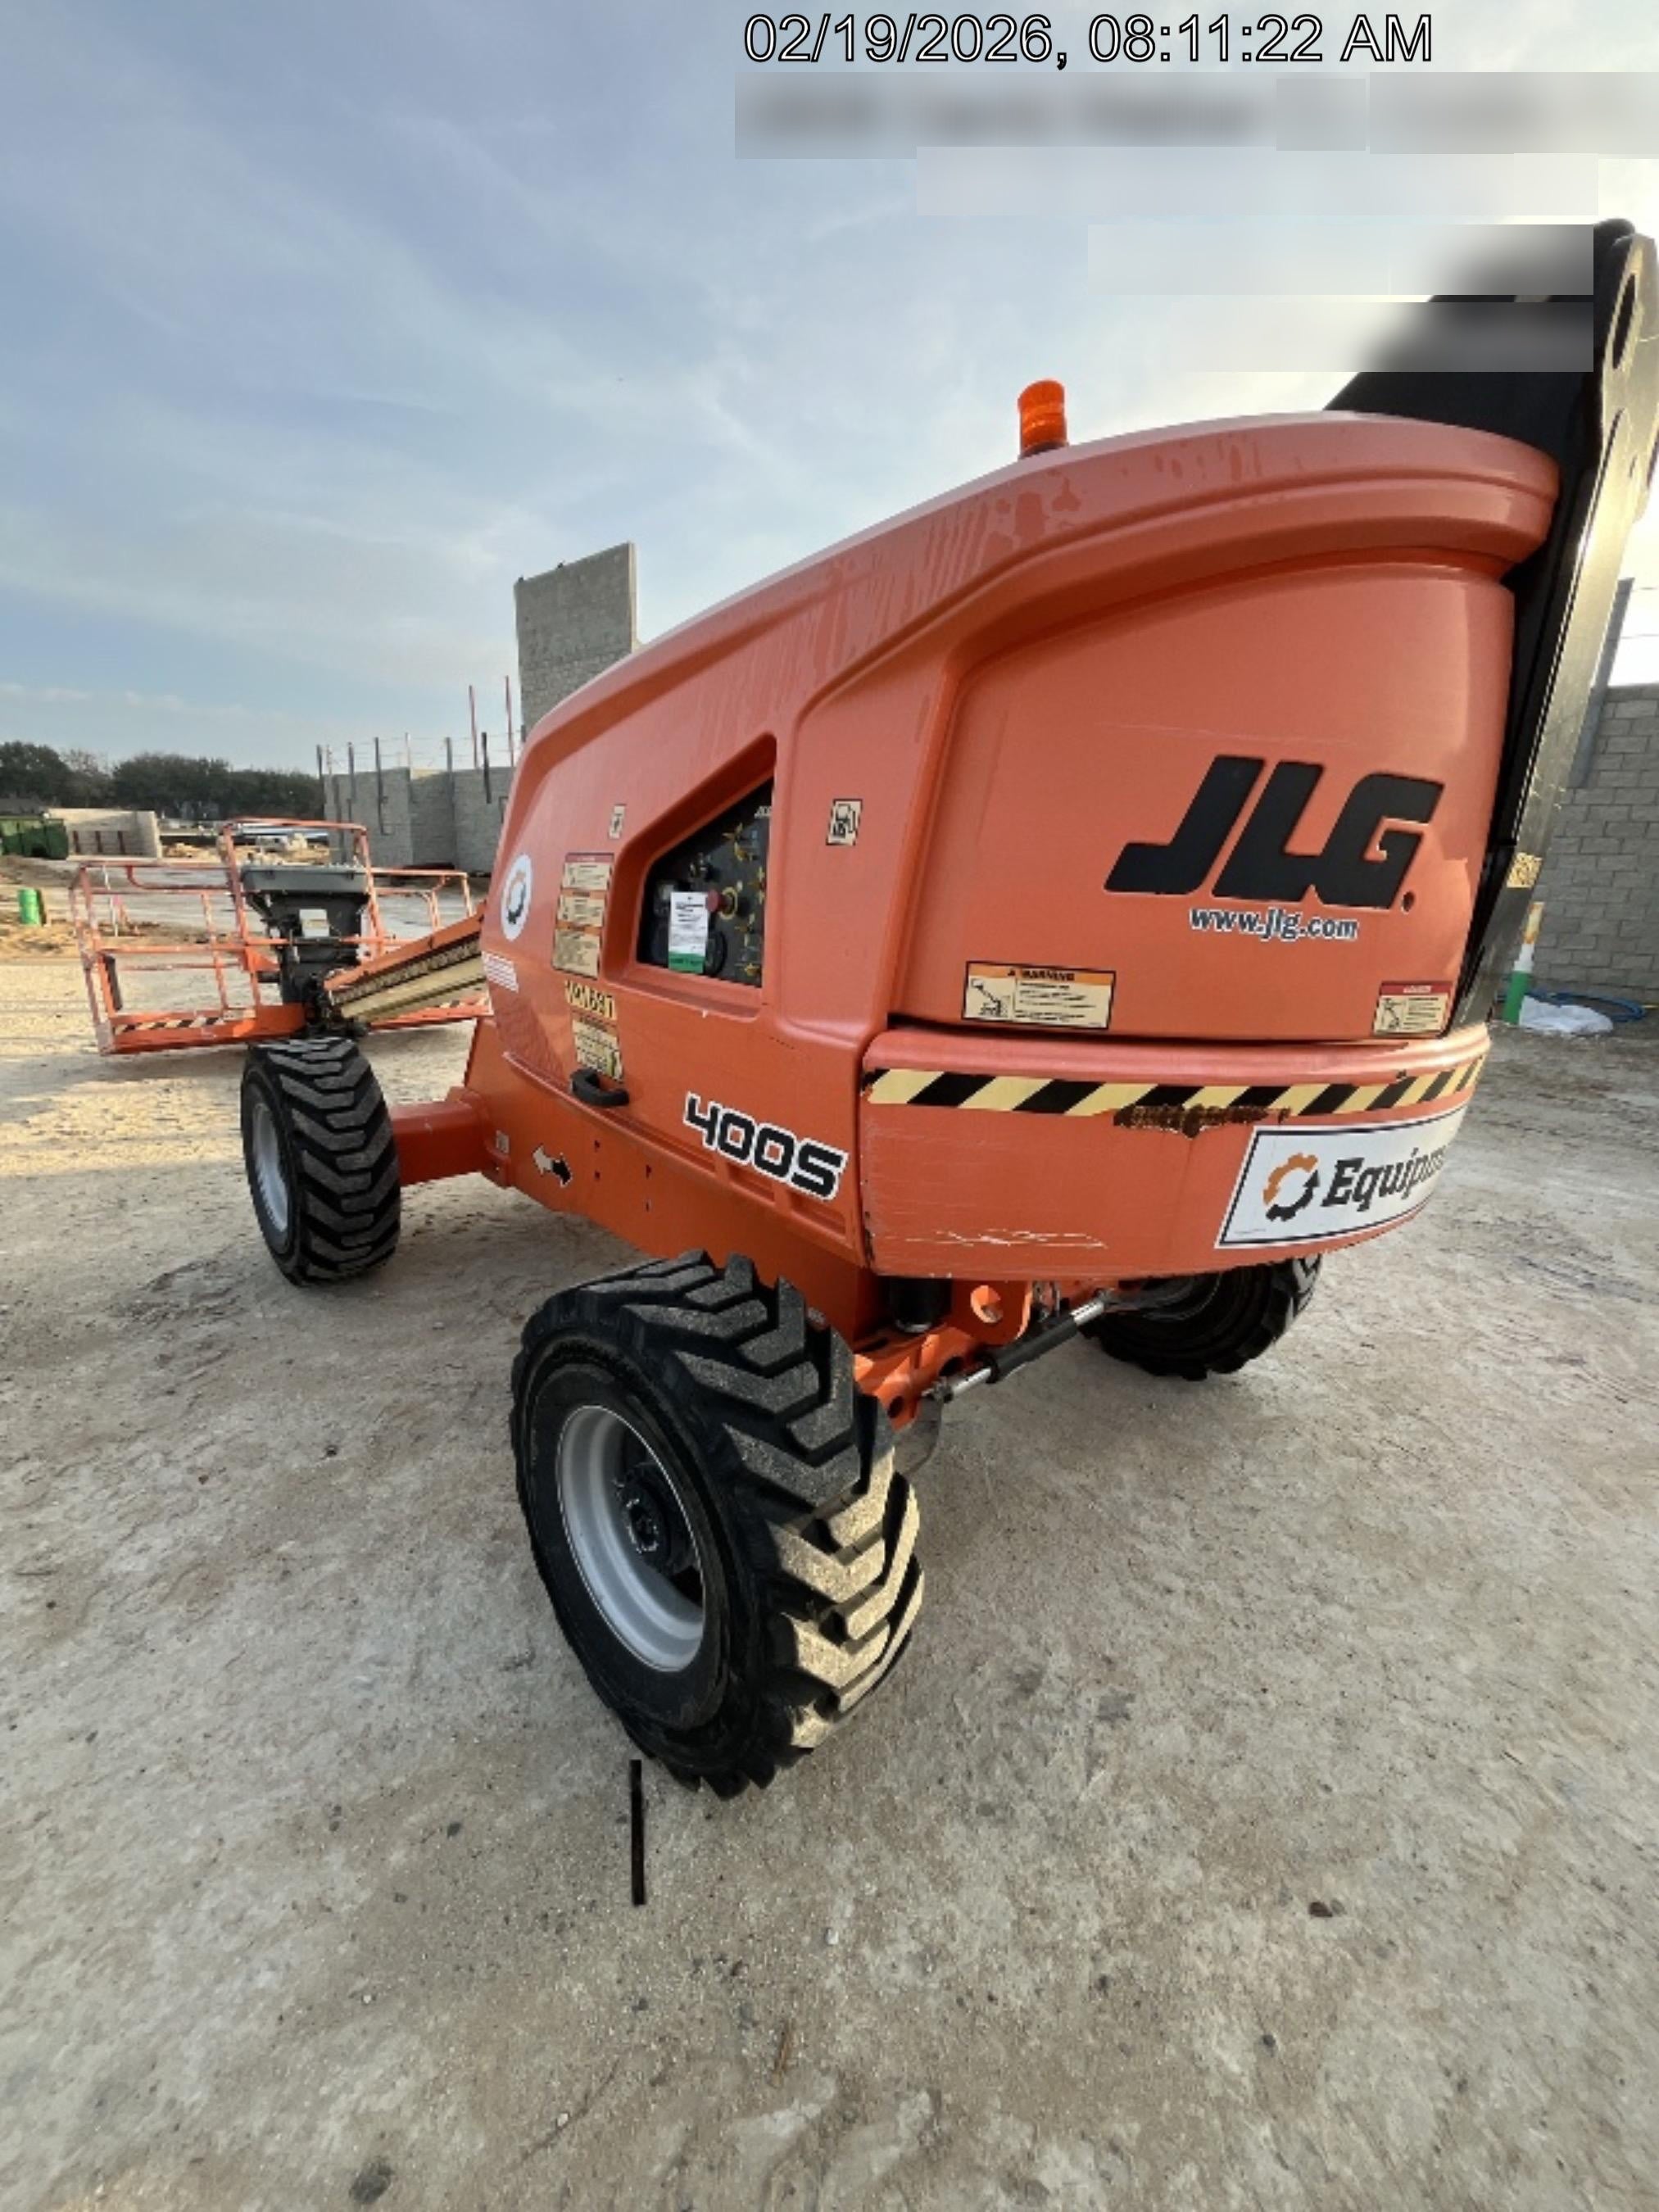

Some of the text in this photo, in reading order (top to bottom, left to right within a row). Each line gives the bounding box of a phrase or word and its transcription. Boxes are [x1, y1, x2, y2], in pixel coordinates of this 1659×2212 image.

[1104, 754, 1444, 910] JLG
[1190, 906, 1359, 942] www.jlg.com
[683, 1090, 849, 1201] 400S
